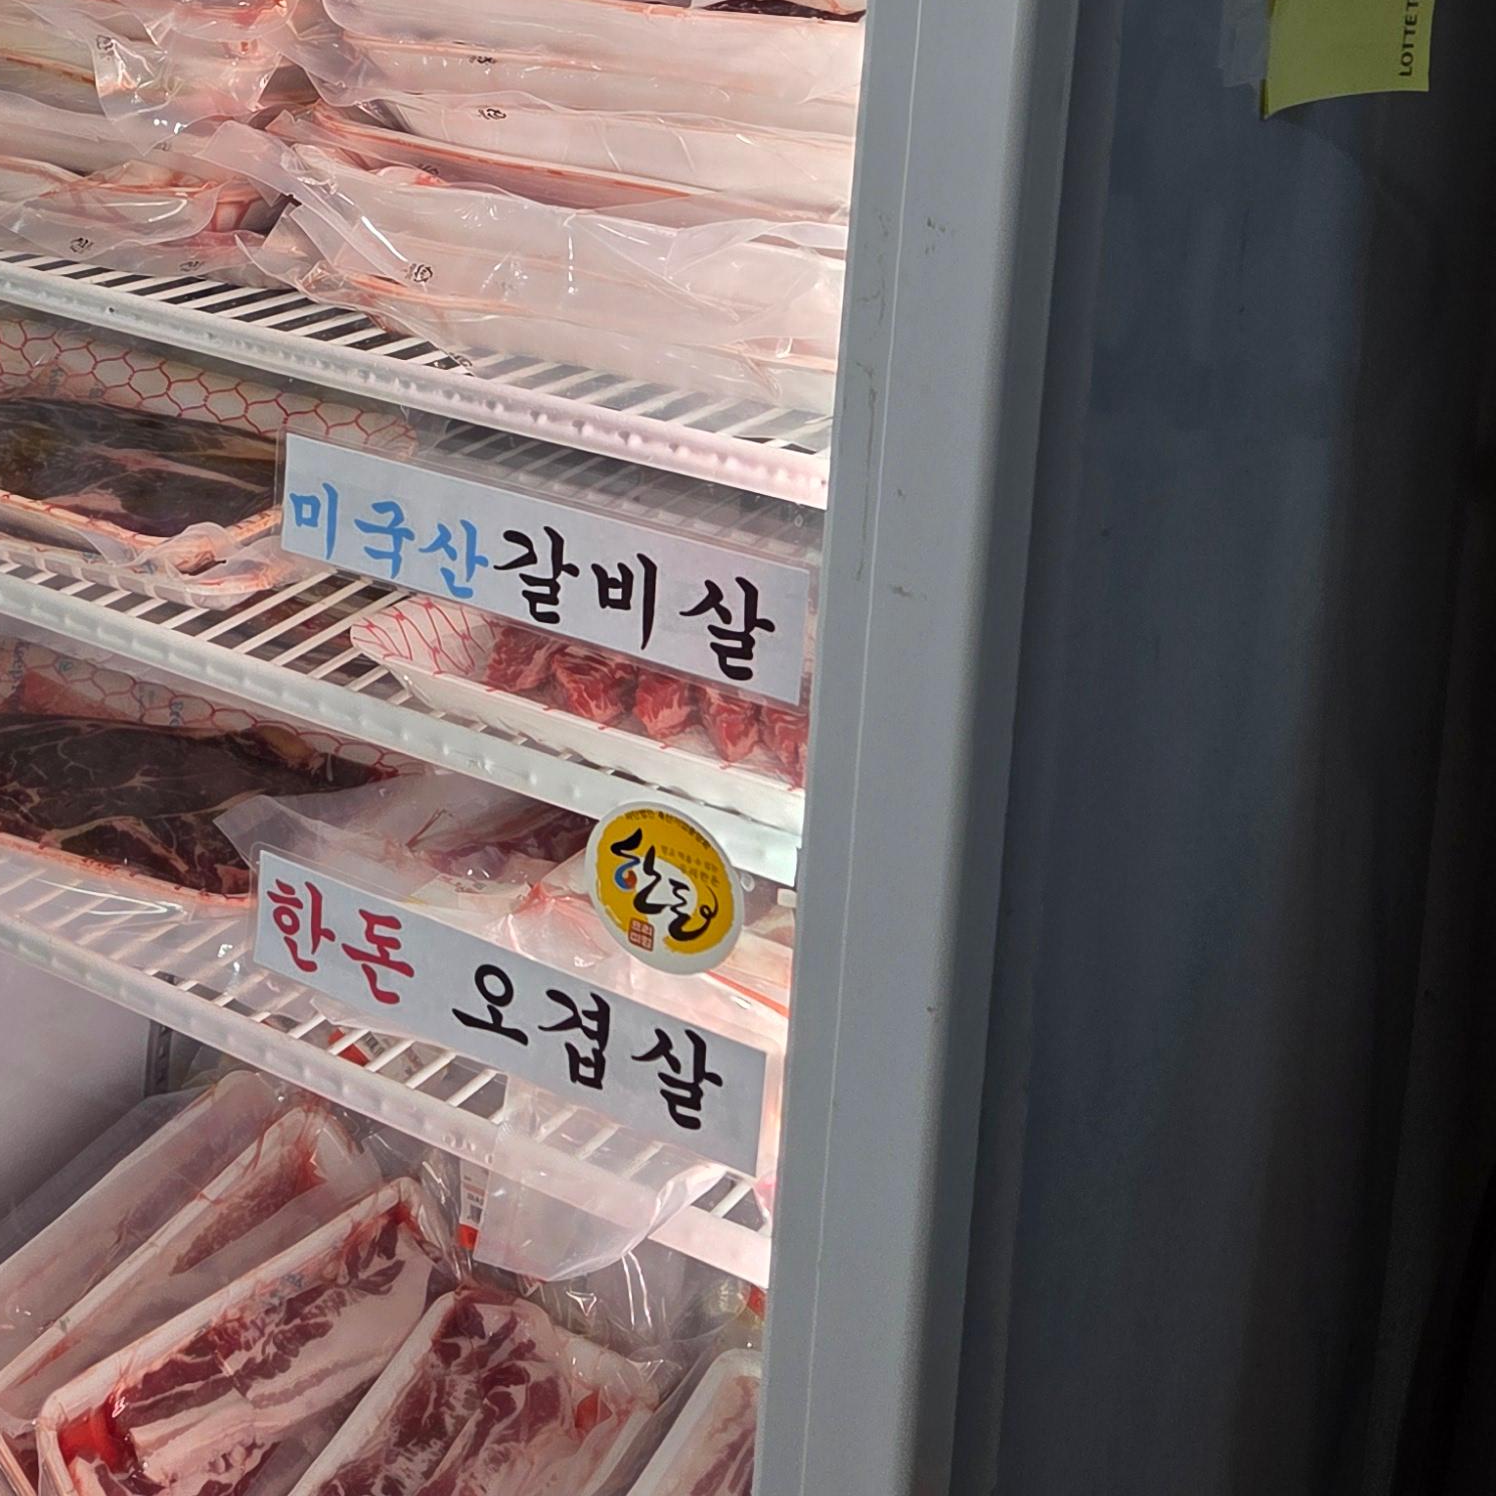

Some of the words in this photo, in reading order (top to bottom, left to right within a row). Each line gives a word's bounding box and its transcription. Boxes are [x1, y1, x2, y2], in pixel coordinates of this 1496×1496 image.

[1398, 14, 1418, 77] LOTTE
[266, 880, 414, 1005] 한돈
[451, 963, 724, 1130] 오겹살
